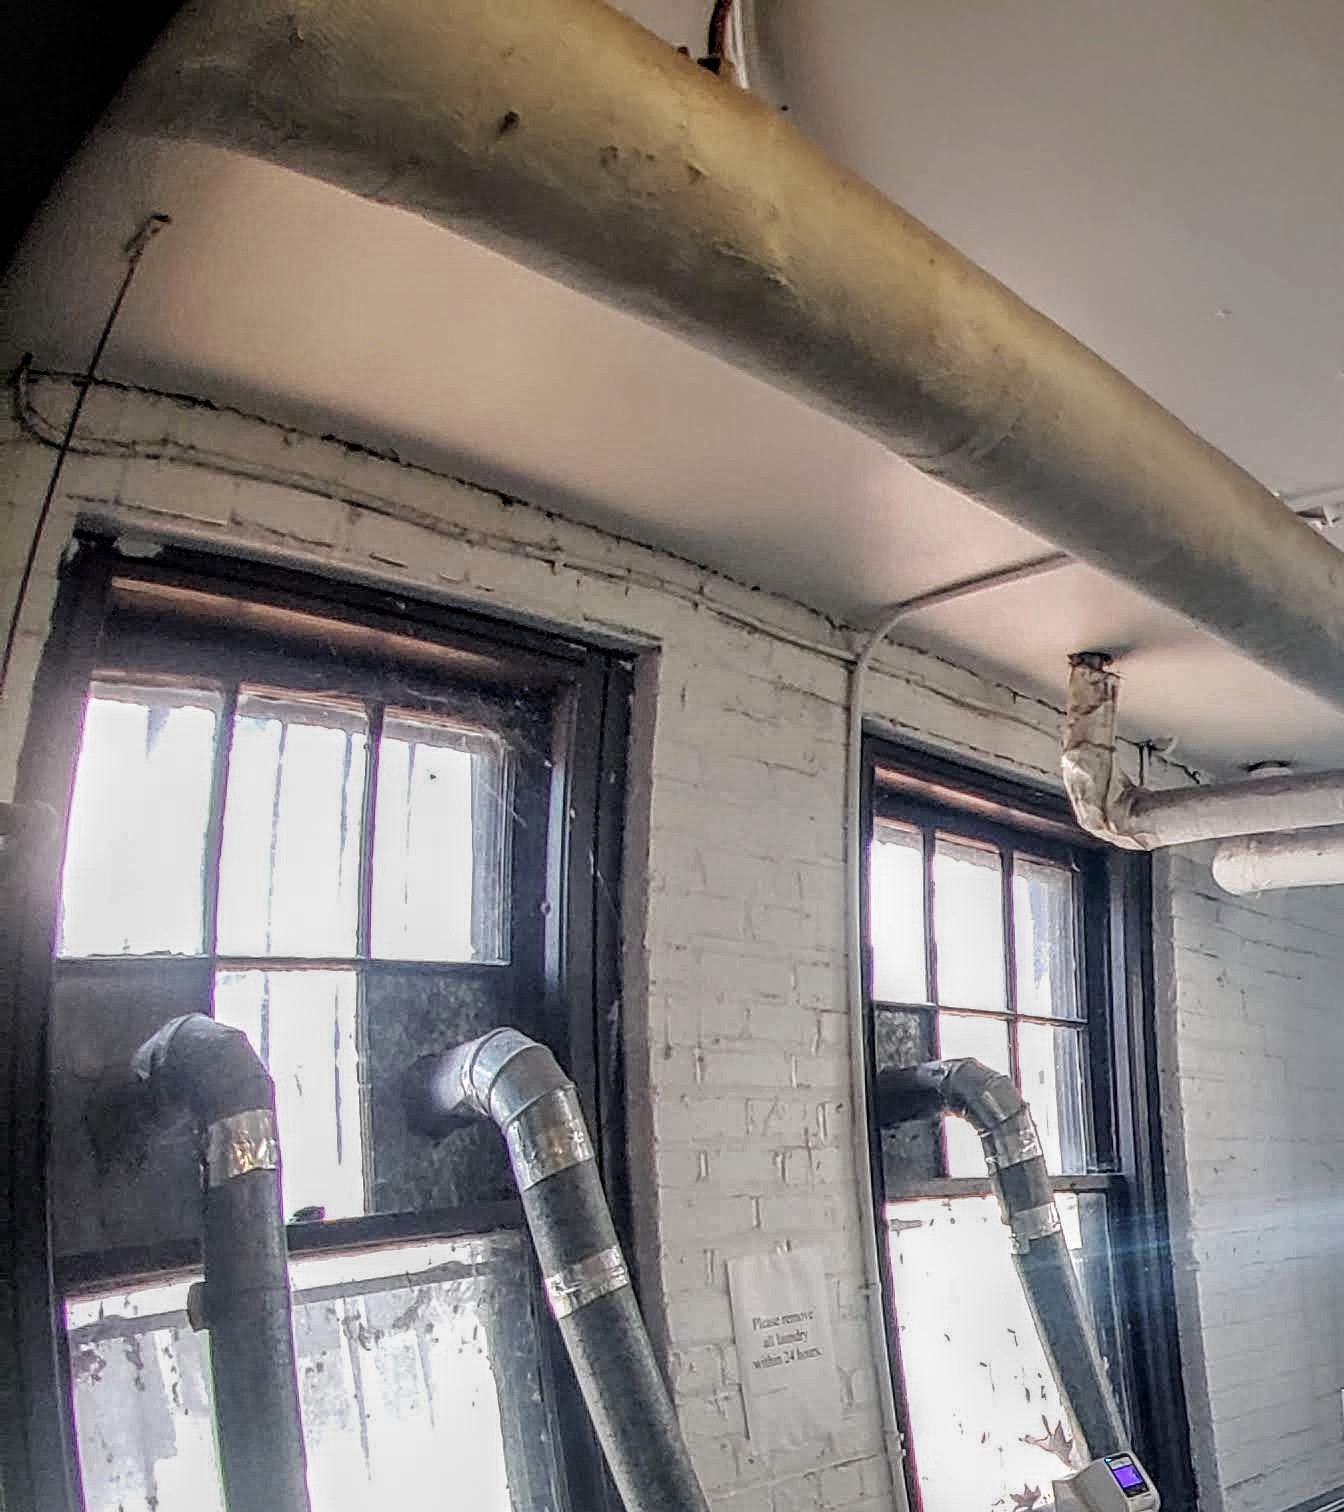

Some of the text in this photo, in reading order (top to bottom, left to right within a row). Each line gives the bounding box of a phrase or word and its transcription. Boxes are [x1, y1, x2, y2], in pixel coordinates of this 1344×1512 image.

[752, 1311, 815, 1331] Please remove
[763, 1328, 808, 1348] all laundry
[752, 1352, 783, 1368] within
[783, 1349, 795, 1364] 24
